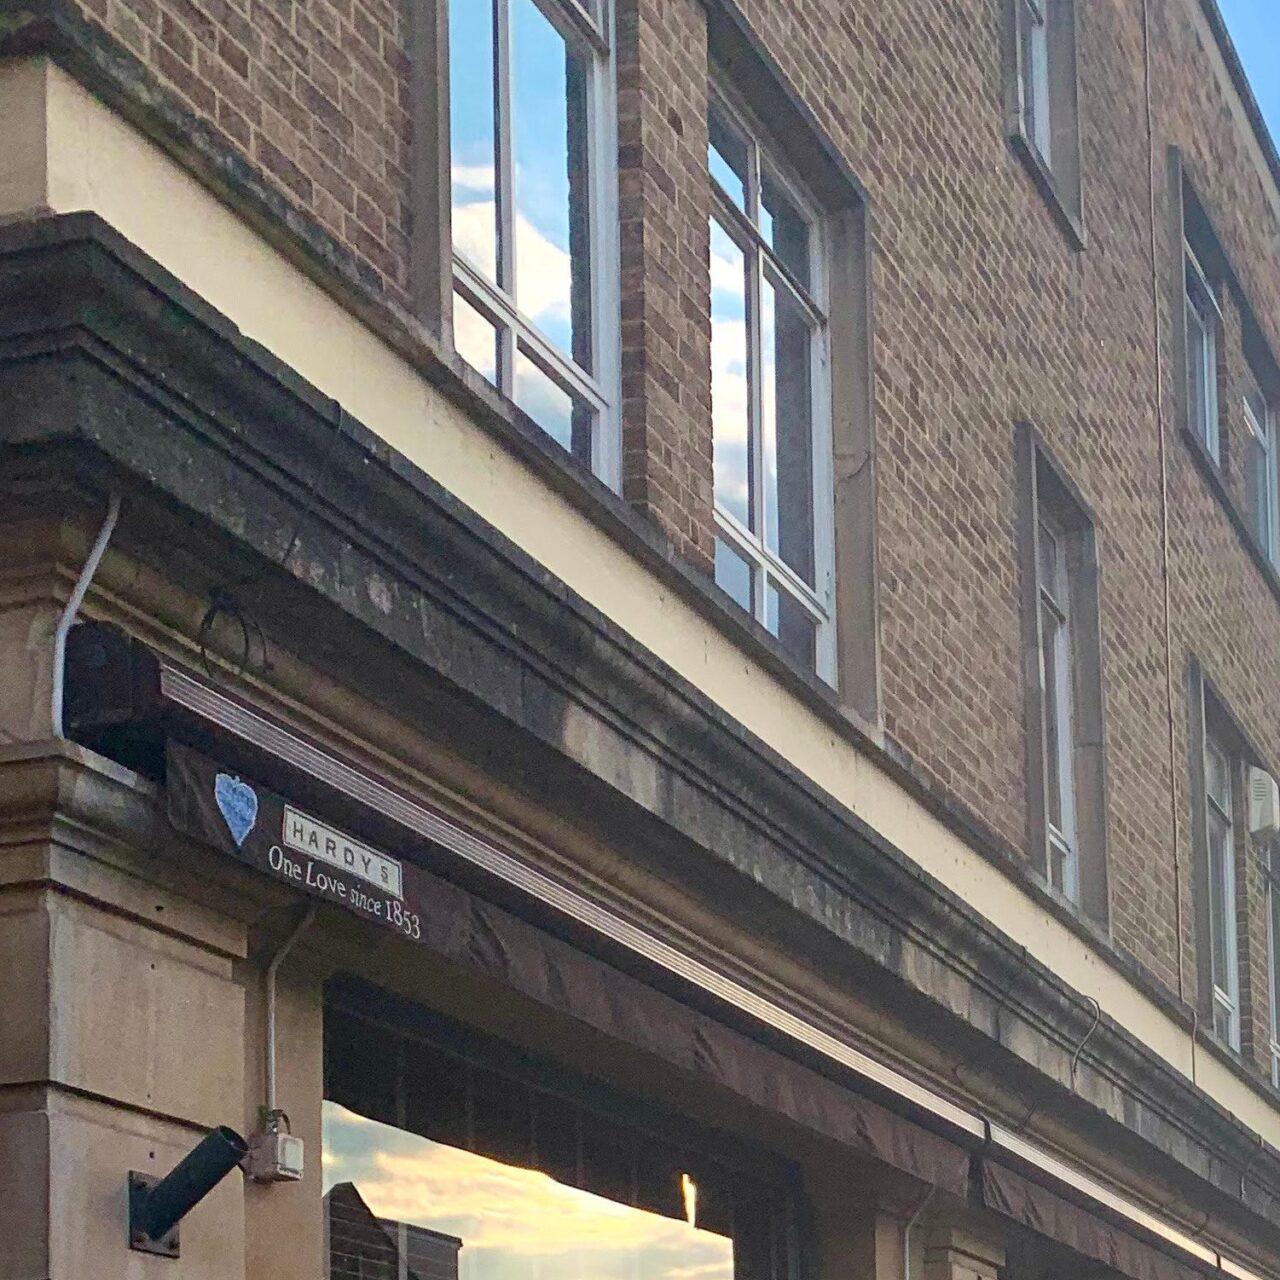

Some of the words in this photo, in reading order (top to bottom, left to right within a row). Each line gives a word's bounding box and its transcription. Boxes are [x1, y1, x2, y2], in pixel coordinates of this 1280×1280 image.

[268, 845, 302, 881] One
[305, 861, 347, 897] Love
[349, 884, 382, 917] since
[385, 900, 421, 940] 1853
[292, 820, 391, 885] HARDYS
